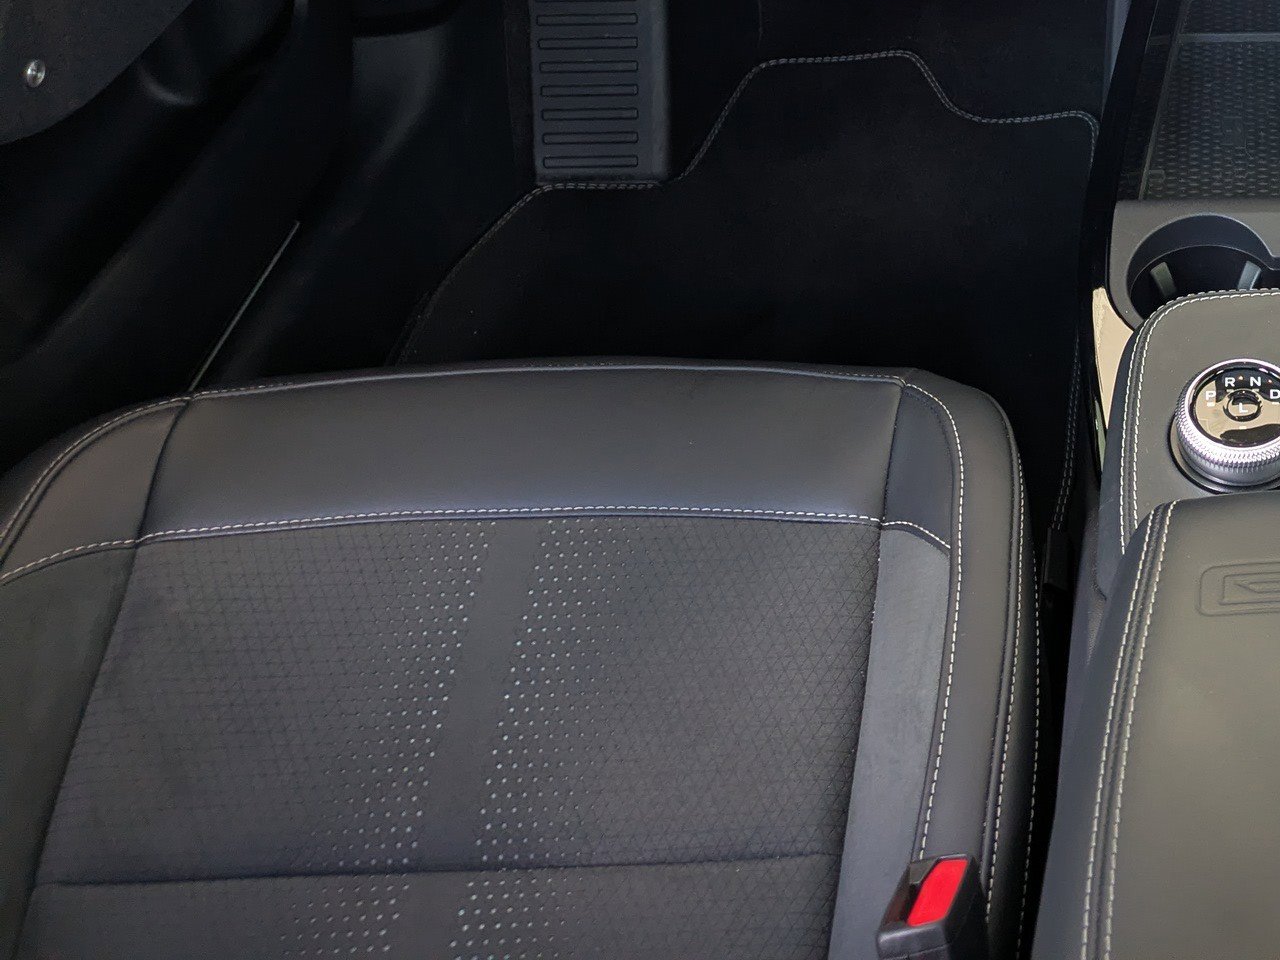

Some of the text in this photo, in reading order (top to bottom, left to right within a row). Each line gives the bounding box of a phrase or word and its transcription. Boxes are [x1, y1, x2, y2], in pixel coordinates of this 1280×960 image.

[1224, 376, 1262, 387] R N
[1205, 390, 1217, 401] P
[1269, 389, 1280, 400] D
[1238, 403, 1249, 414] L
